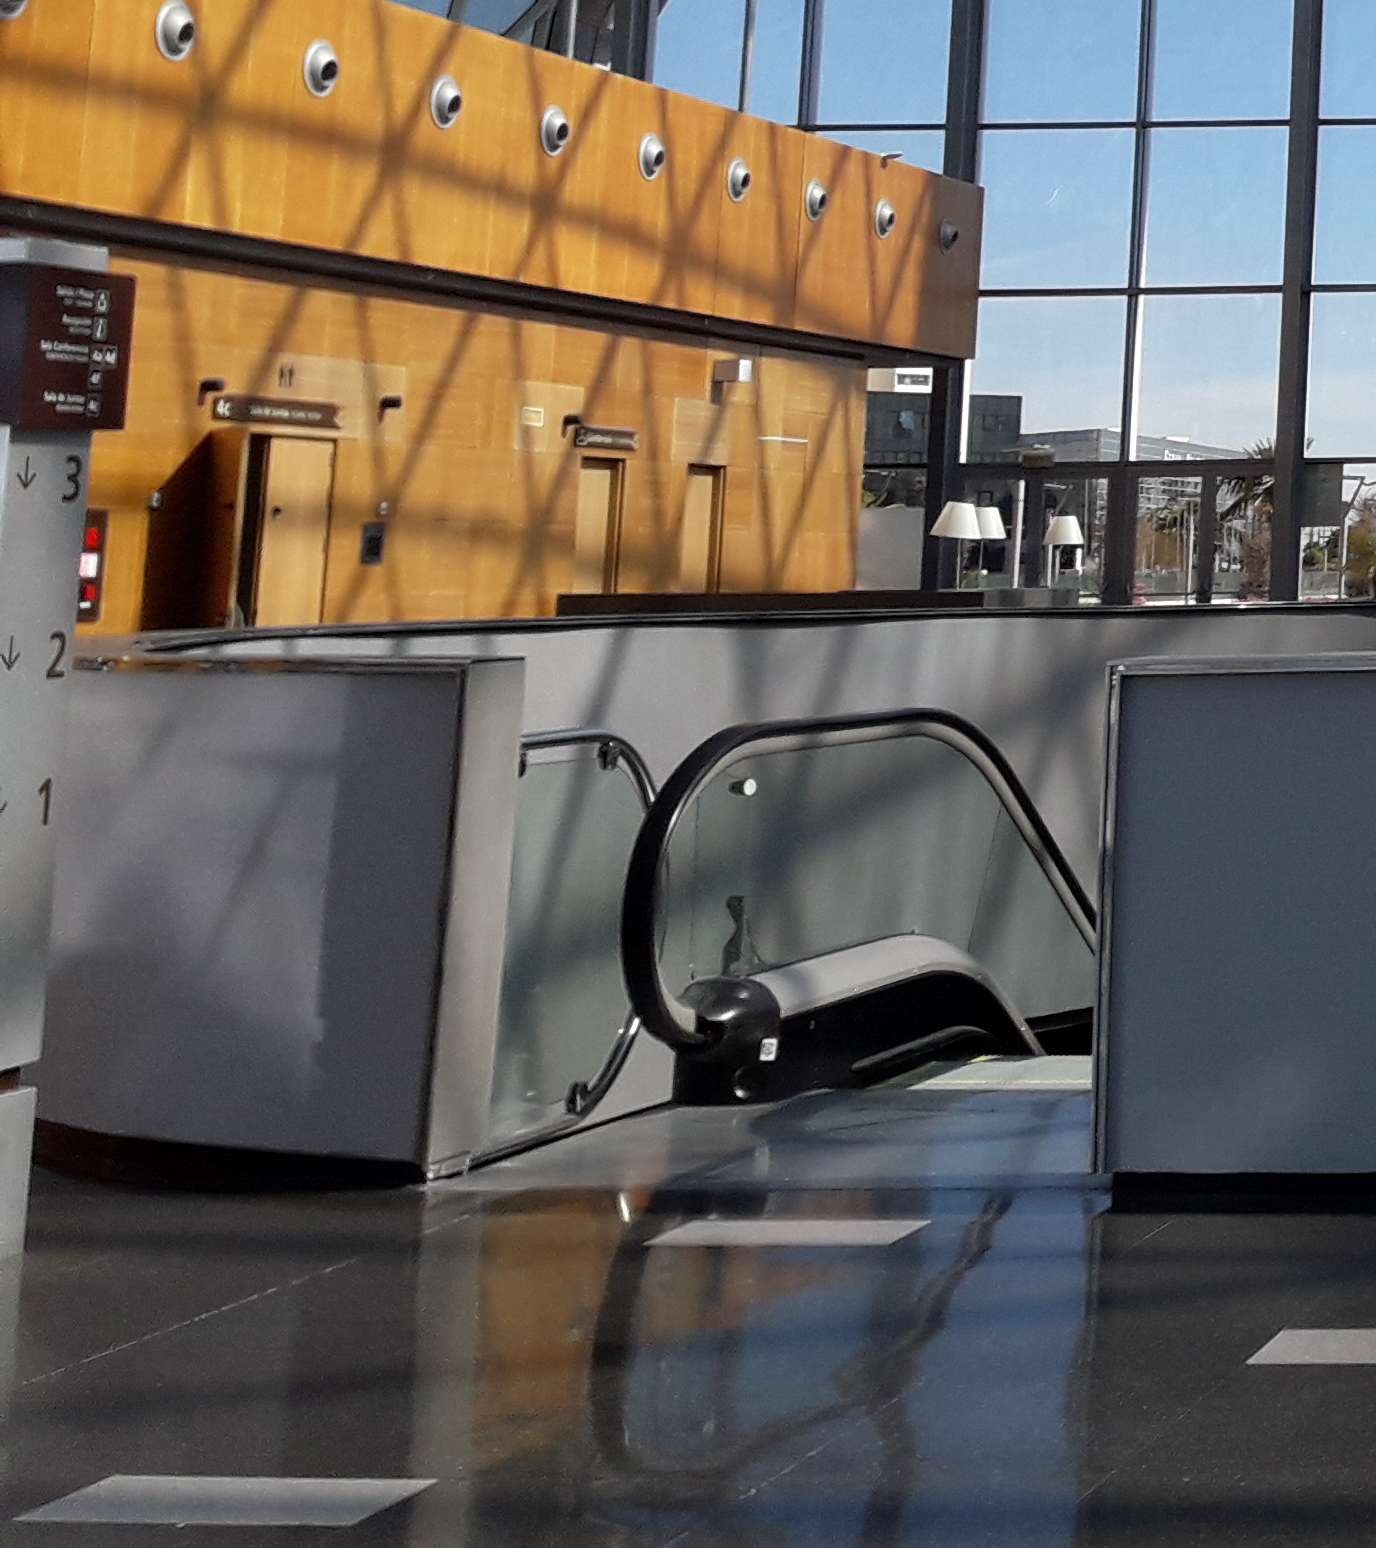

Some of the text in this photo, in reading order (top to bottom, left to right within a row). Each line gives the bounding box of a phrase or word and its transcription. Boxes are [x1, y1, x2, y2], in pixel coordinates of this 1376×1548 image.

[61, 454, 83, 504] 3
[46, 631, 66, 680] 2
[38, 777, 53, 826] 1
